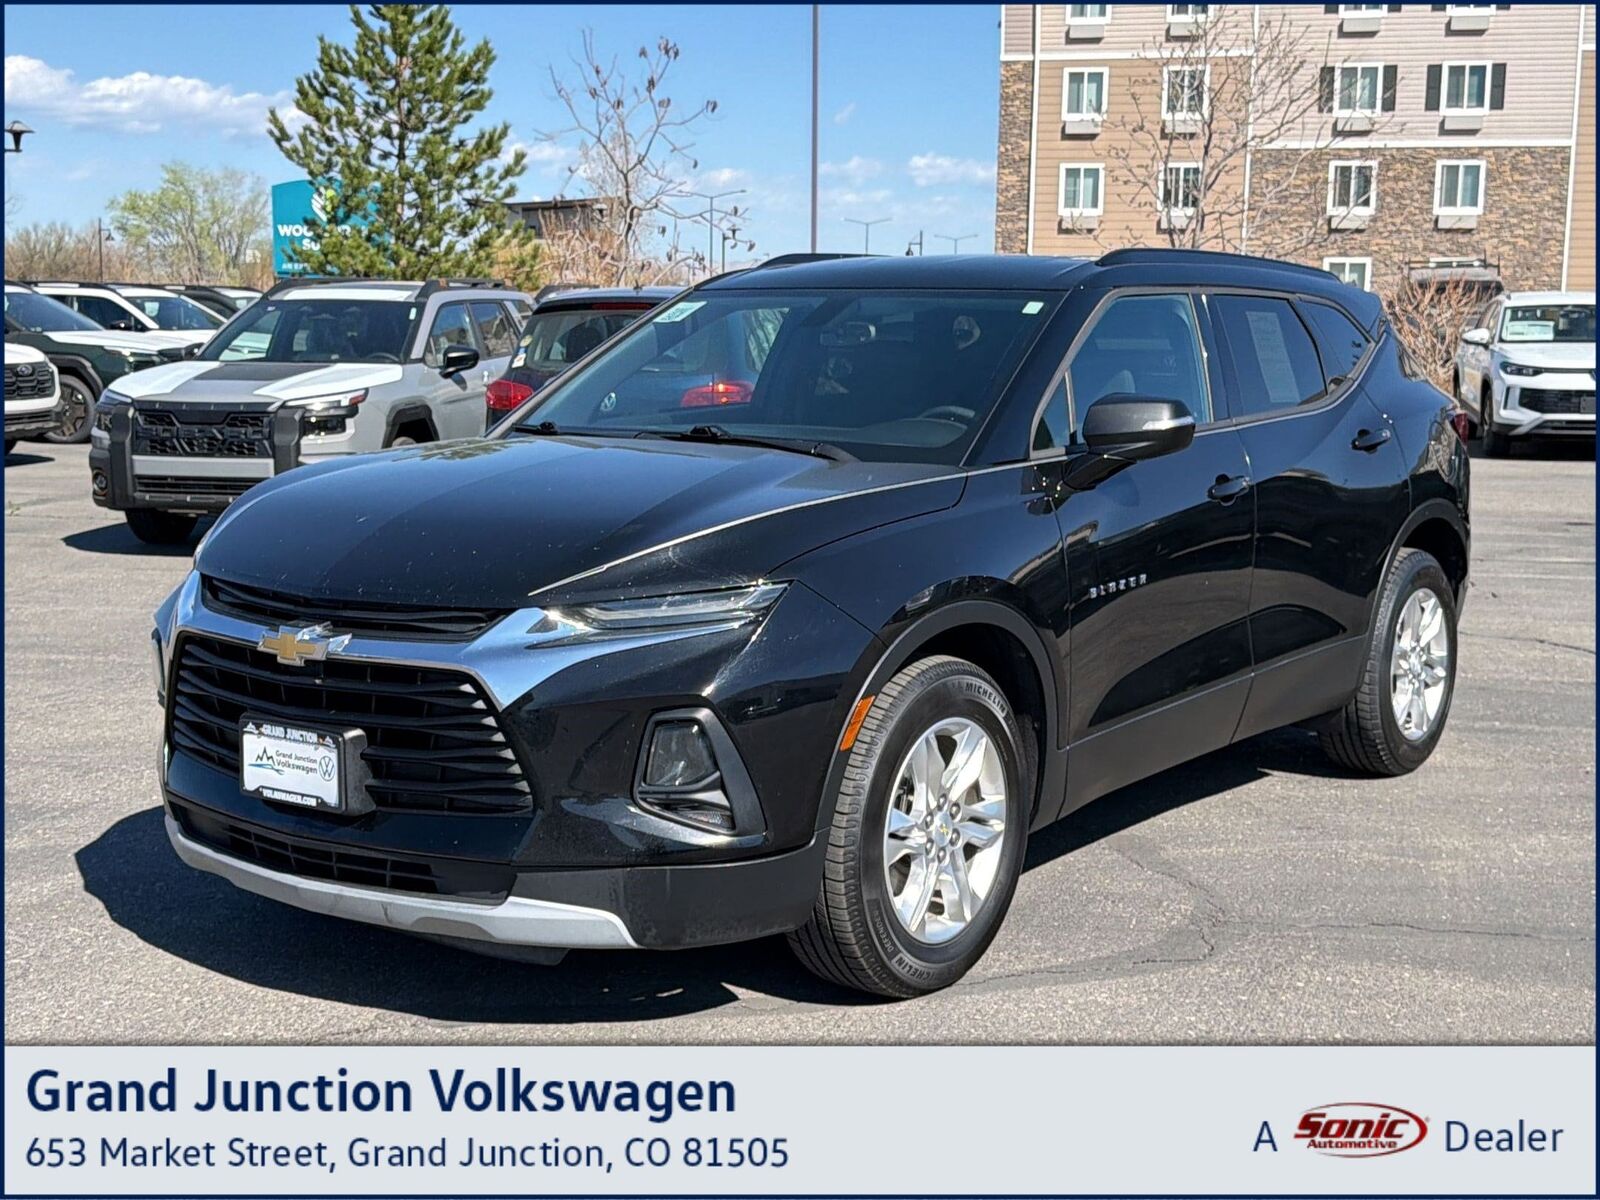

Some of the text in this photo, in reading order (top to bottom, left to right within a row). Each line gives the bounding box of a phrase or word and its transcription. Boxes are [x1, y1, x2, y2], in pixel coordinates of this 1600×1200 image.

[1090, 573, 1147, 599] BLAZER
[965, 682, 1006, 714] MICHELIN
[262, 724, 318, 742] GRAND JUNCTION
[275, 750, 318, 764] Grand Junction
[276, 759, 318, 774] Volkswagen
[895, 956, 938, 981] ICHELIN
